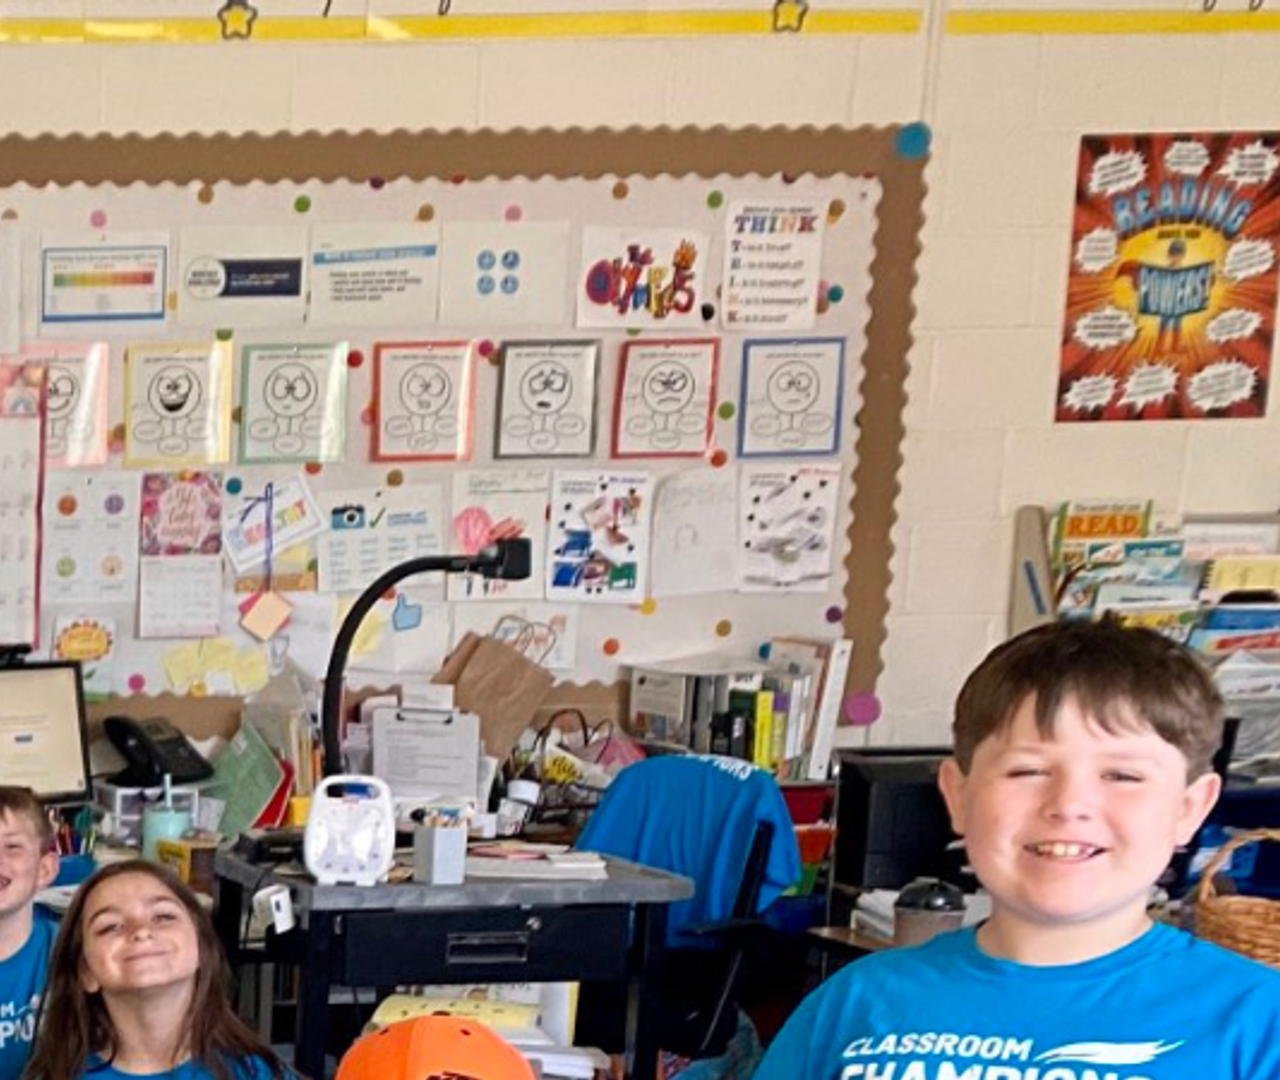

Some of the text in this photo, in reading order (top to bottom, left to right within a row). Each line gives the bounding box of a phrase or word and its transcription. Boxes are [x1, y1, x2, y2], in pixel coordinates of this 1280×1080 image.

[1113, 174, 1253, 240] READING
[734, 215, 818, 234] THINK
[1068, 515, 1139, 538] READ
[842, 1031, 1034, 1062] CLASSROOM
